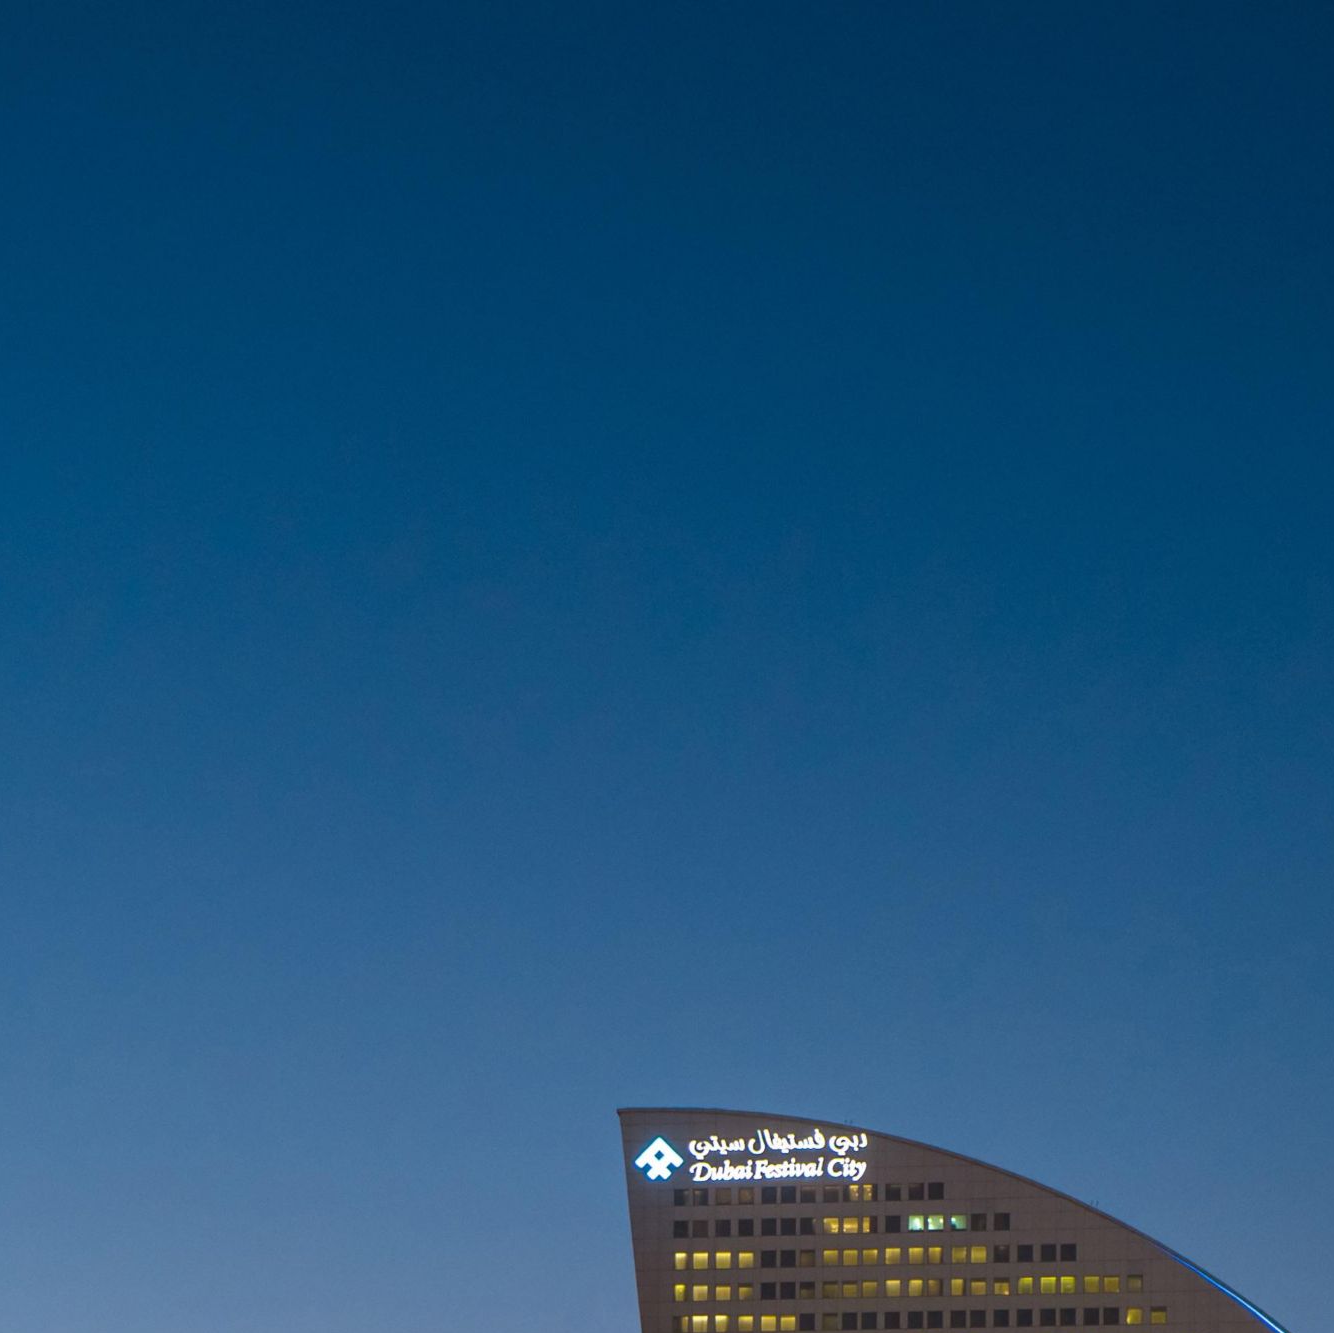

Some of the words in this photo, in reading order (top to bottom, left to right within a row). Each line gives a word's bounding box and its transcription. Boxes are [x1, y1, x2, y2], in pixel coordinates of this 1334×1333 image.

[688, 1134, 746, 1161] سيتي
[829, 1132, 869, 1156] دبي
[689, 1158, 753, 1182] Dubai
[753, 1156, 824, 1181] Festival
[826, 1156, 868, 1182] City
